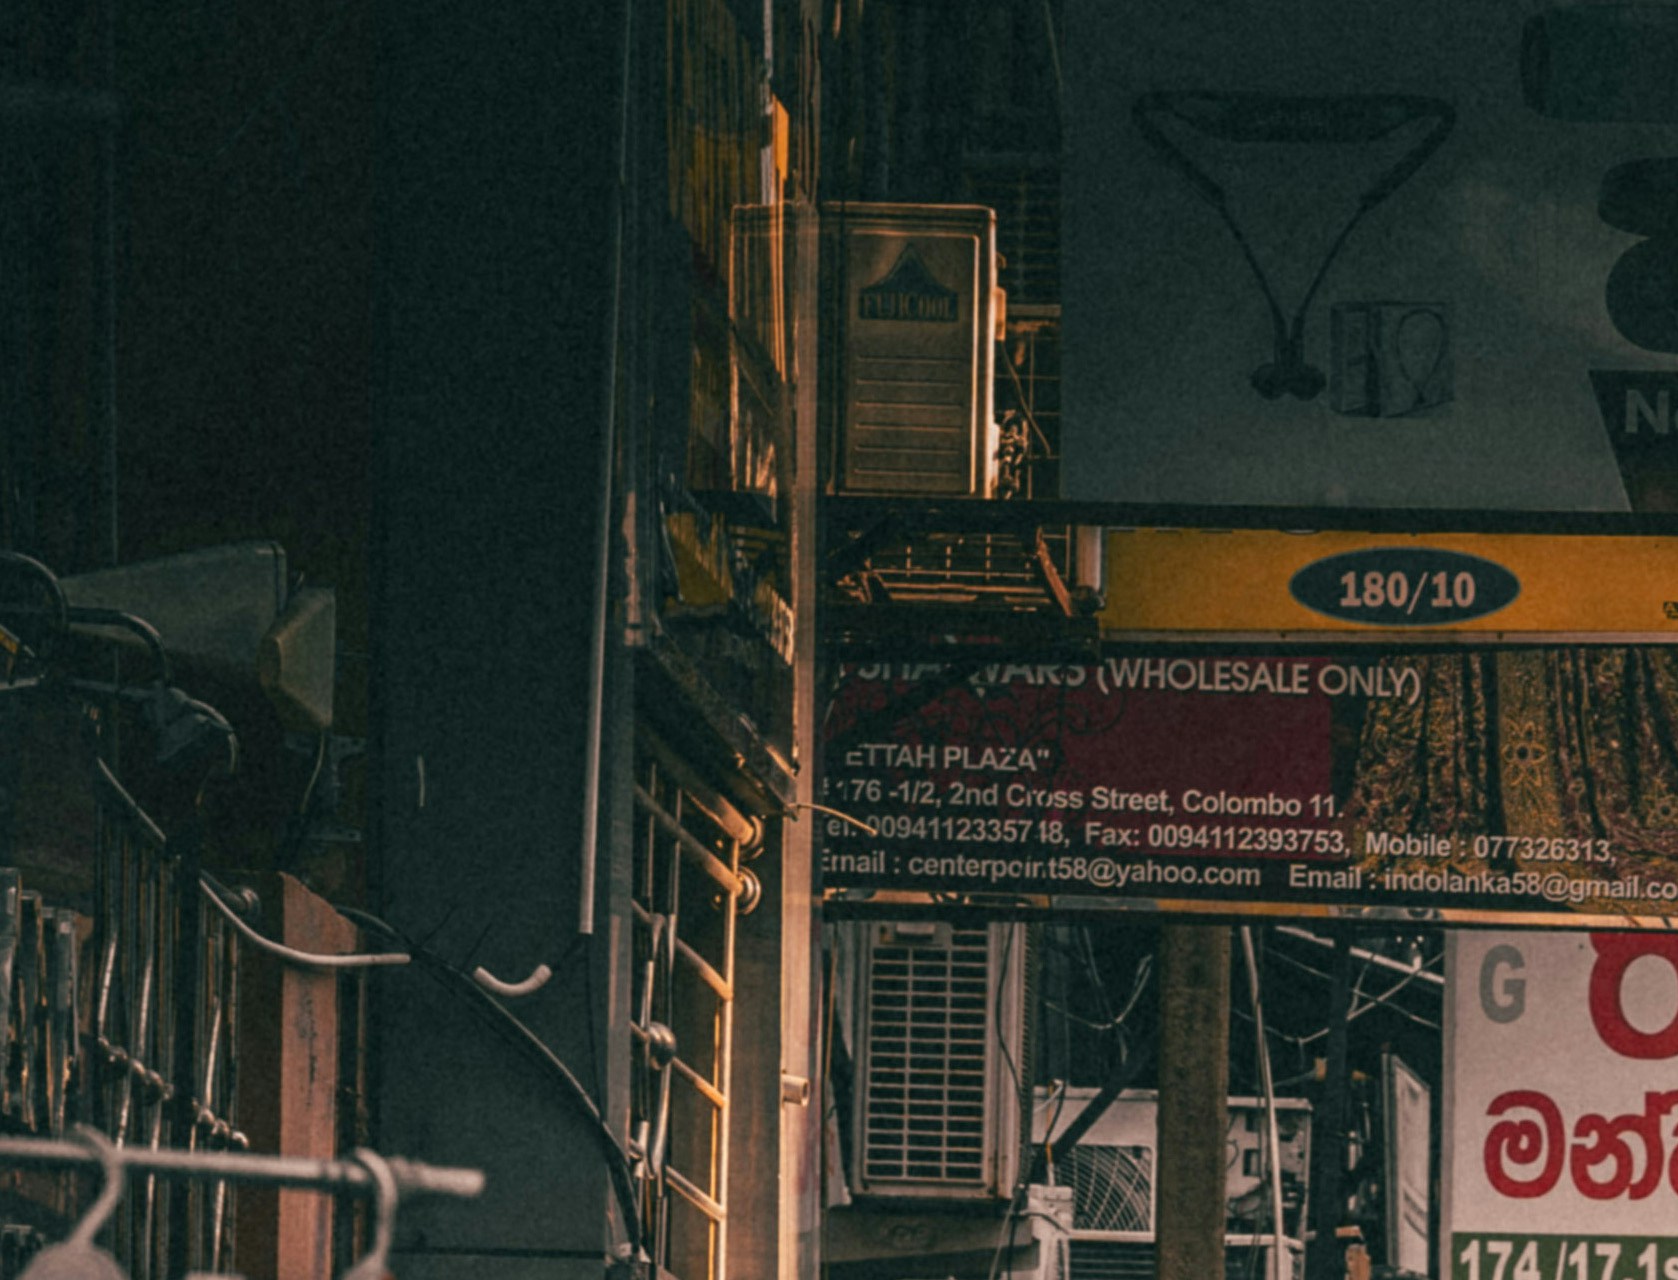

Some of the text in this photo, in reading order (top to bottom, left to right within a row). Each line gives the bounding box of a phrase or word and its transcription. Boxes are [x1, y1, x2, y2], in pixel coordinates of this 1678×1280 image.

[1339, 571, 1477, 614] 180/10
[1097, 657, 1422, 706] (WHOLESALE ONLY)
[952, 782, 998, 807] 2nd
[1008, 783, 1083, 810] Cross
[1091, 785, 1175, 816] Street,
[1182, 789, 1301, 818] Colombo
[1310, 795, 1345, 818] 11.
[1085, 820, 1139, 848] Fax:
[1148, 824, 1351, 858] 0094112393753,
[1365, 831, 1452, 859] Mobile
[1474, 836, 1617, 867] 077326313,
[1289, 864, 1362, 890] Email
